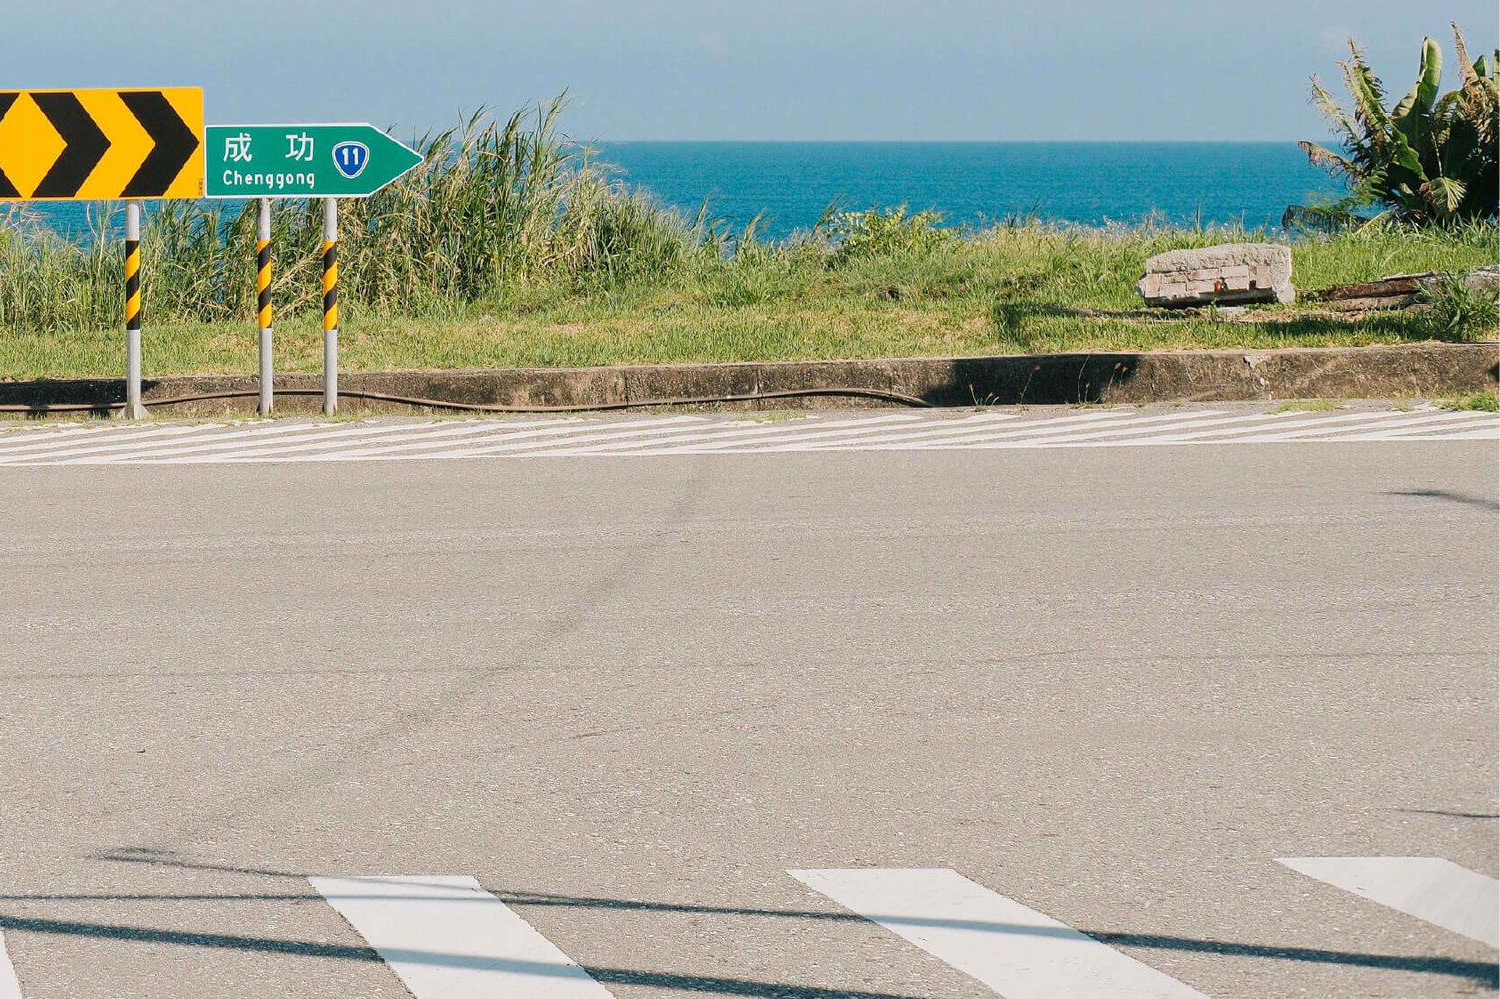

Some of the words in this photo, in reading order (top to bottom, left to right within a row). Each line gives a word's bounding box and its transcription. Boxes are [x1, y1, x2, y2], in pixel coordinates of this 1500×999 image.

[223, 132, 315, 162] 成功
[342, 147, 360, 166] 11
[223, 169, 316, 190] Chenggong
